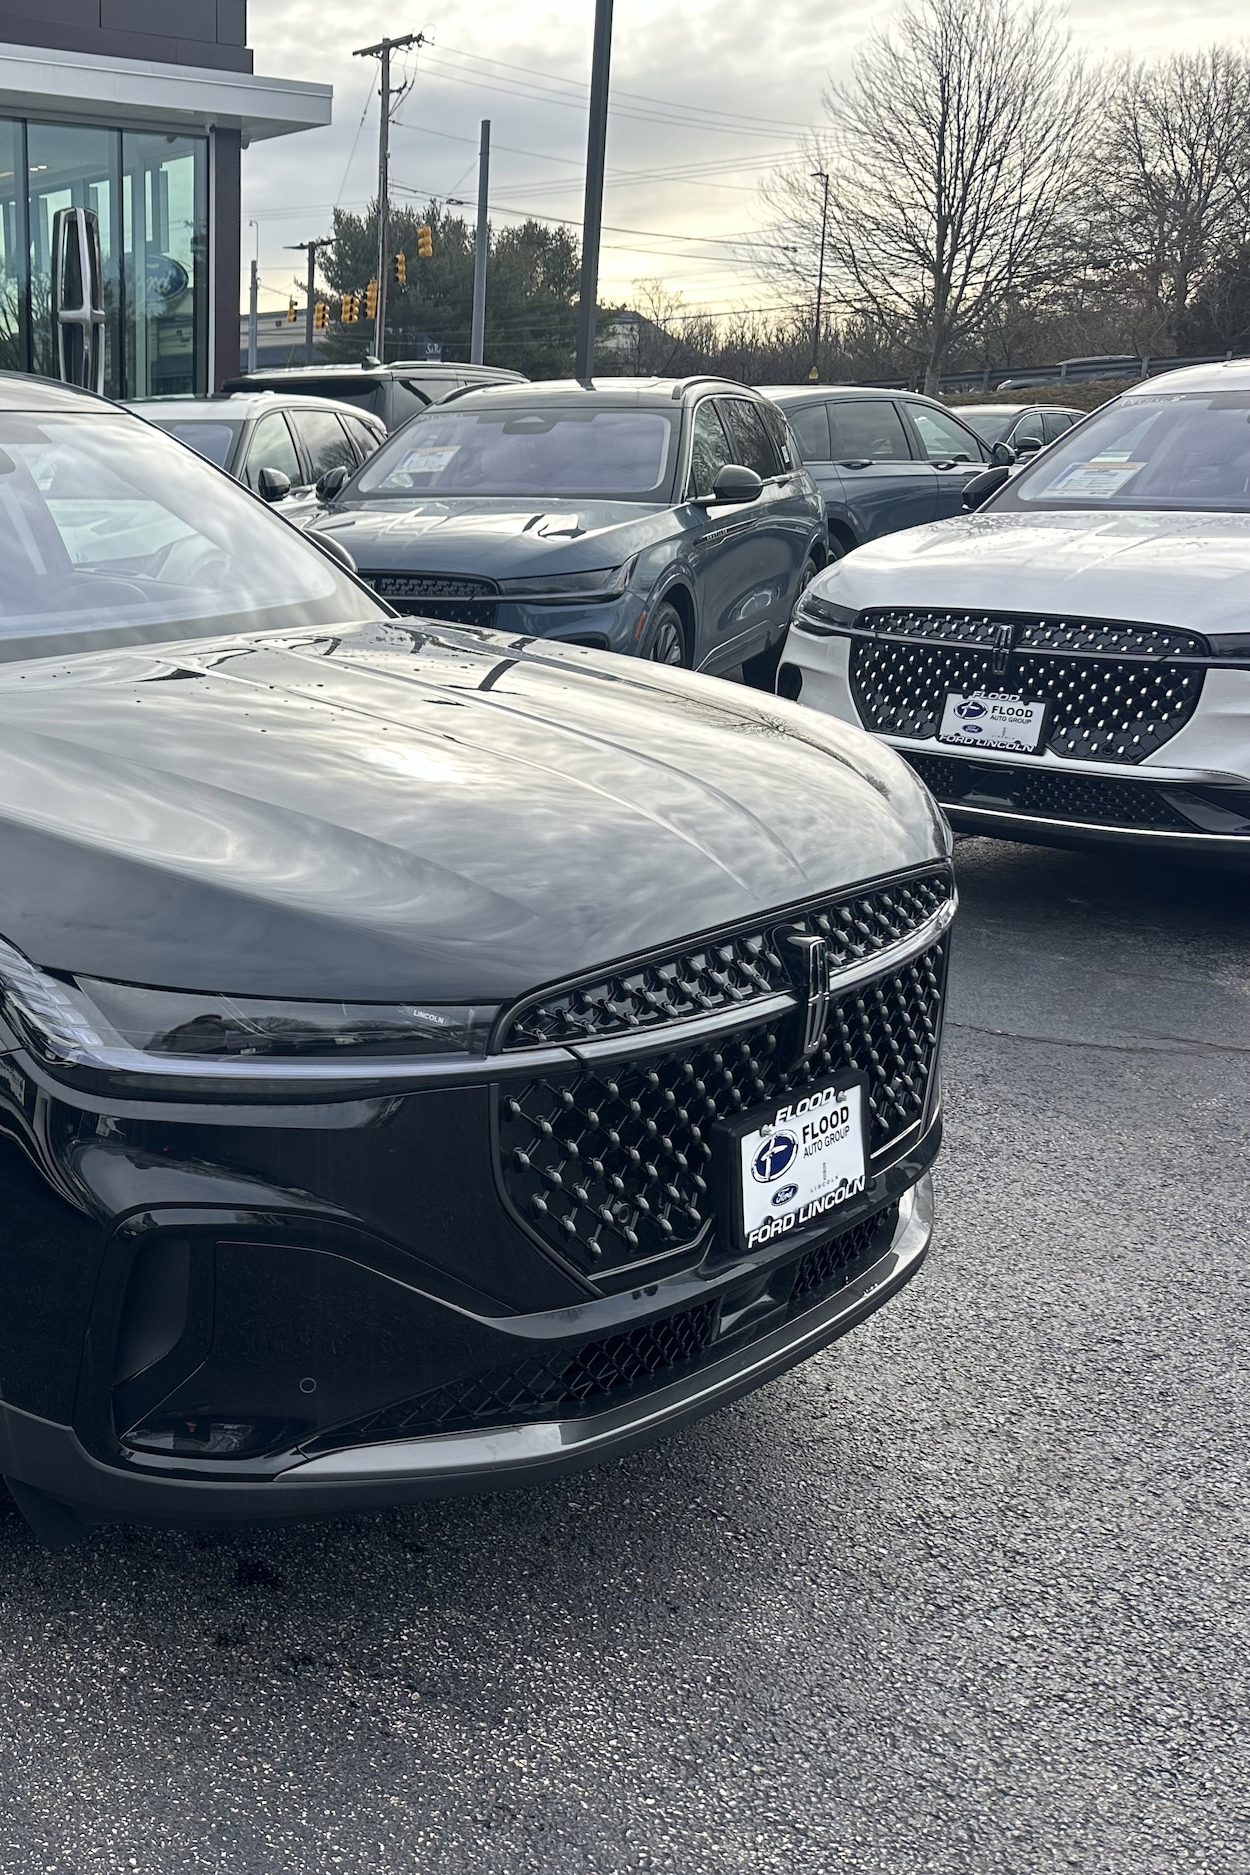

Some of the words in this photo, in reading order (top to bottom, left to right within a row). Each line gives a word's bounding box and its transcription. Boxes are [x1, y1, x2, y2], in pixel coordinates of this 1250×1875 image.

[972, 690, 1020, 701] FLOOD
[991, 705, 1033, 718] FLOOD
[1008, 716, 1032, 725] GROUP
[939, 734, 976, 744] FORD
[976, 739, 1035, 752] LINCOLN
[413, 1009, 445, 1024] LINCOLN
[775, 1087, 835, 1123] FLOOD
[802, 1106, 849, 1144] FLOOD
[803, 1140, 823, 1159] AUTO
[824, 1126, 851, 1147] GROUP
[810, 1175, 839, 1193] LINCOLN
[747, 1212, 795, 1249] FORD
[798, 1175, 866, 1224] LINCOLN
